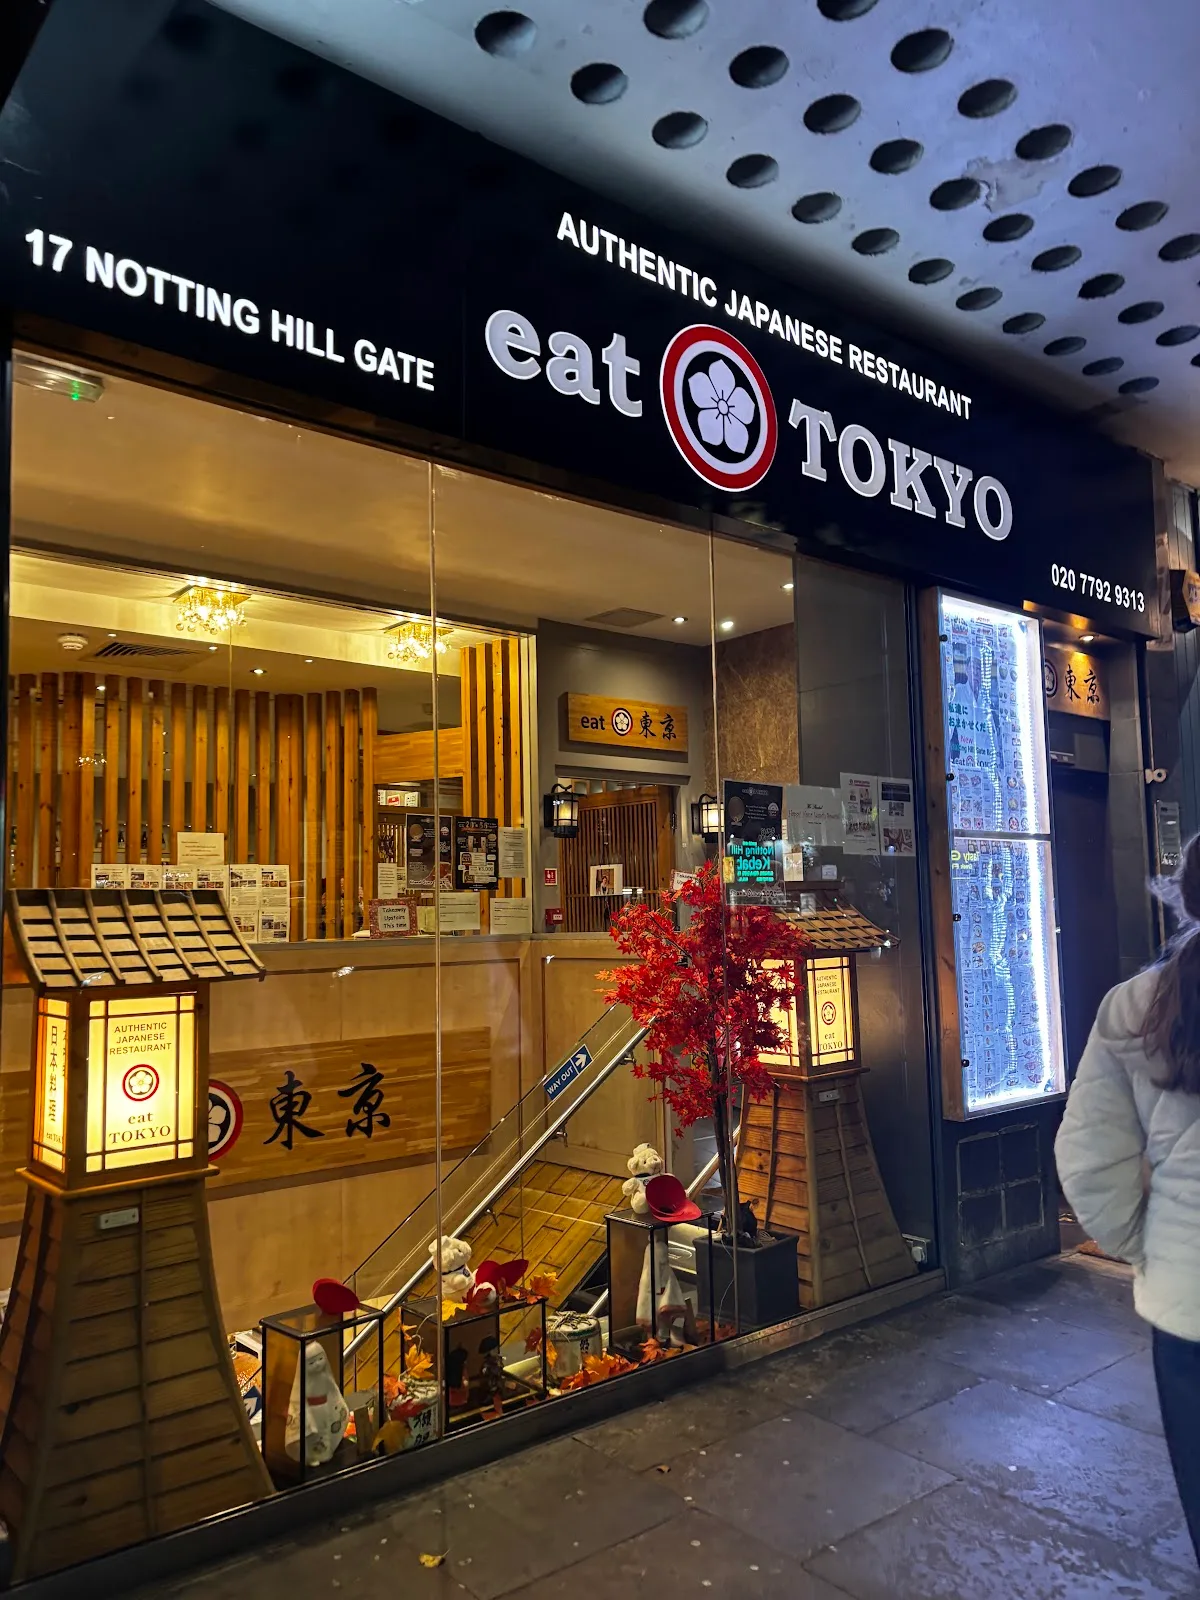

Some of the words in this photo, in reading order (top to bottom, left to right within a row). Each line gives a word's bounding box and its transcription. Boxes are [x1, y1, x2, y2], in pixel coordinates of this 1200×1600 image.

[25, 228, 73, 273] 17
[85, 246, 260, 335] NOTTING
[271, 309, 345, 363] HILL
[353, 338, 435, 392] GATE
[556, 211, 718, 308] AUTHENTIC
[724, 289, 843, 365] JAPANESE
[848, 343, 972, 420] RESTAURANT
[483, 308, 644, 420] eat
[787, 397, 1014, 542] TOKYO
[1051, 563, 1076, 592] 020
[1080, 572, 1112, 603] 7792
[1114, 584, 1146, 614] 9313
[1065, 664, 1100, 705] 東京
[580, 715, 605, 731] eat
[639, 710, 677, 741] 東京
[960, 735, 974, 744] New
[817, 981, 837, 989] JAPANESE
[113, 1021, 168, 1034] AUTHENTIC
[115, 1032, 166, 1045] JAPANESE
[109, 1042, 172, 1055] RESTAURANT
[547, 1079, 561, 1094] WAY
[562, 1066, 574, 1080] OUT
[263, 1062, 391, 1150] 東京
[128, 1111, 154, 1126] eat
[109, 1124, 172, 1145] TOKYO
